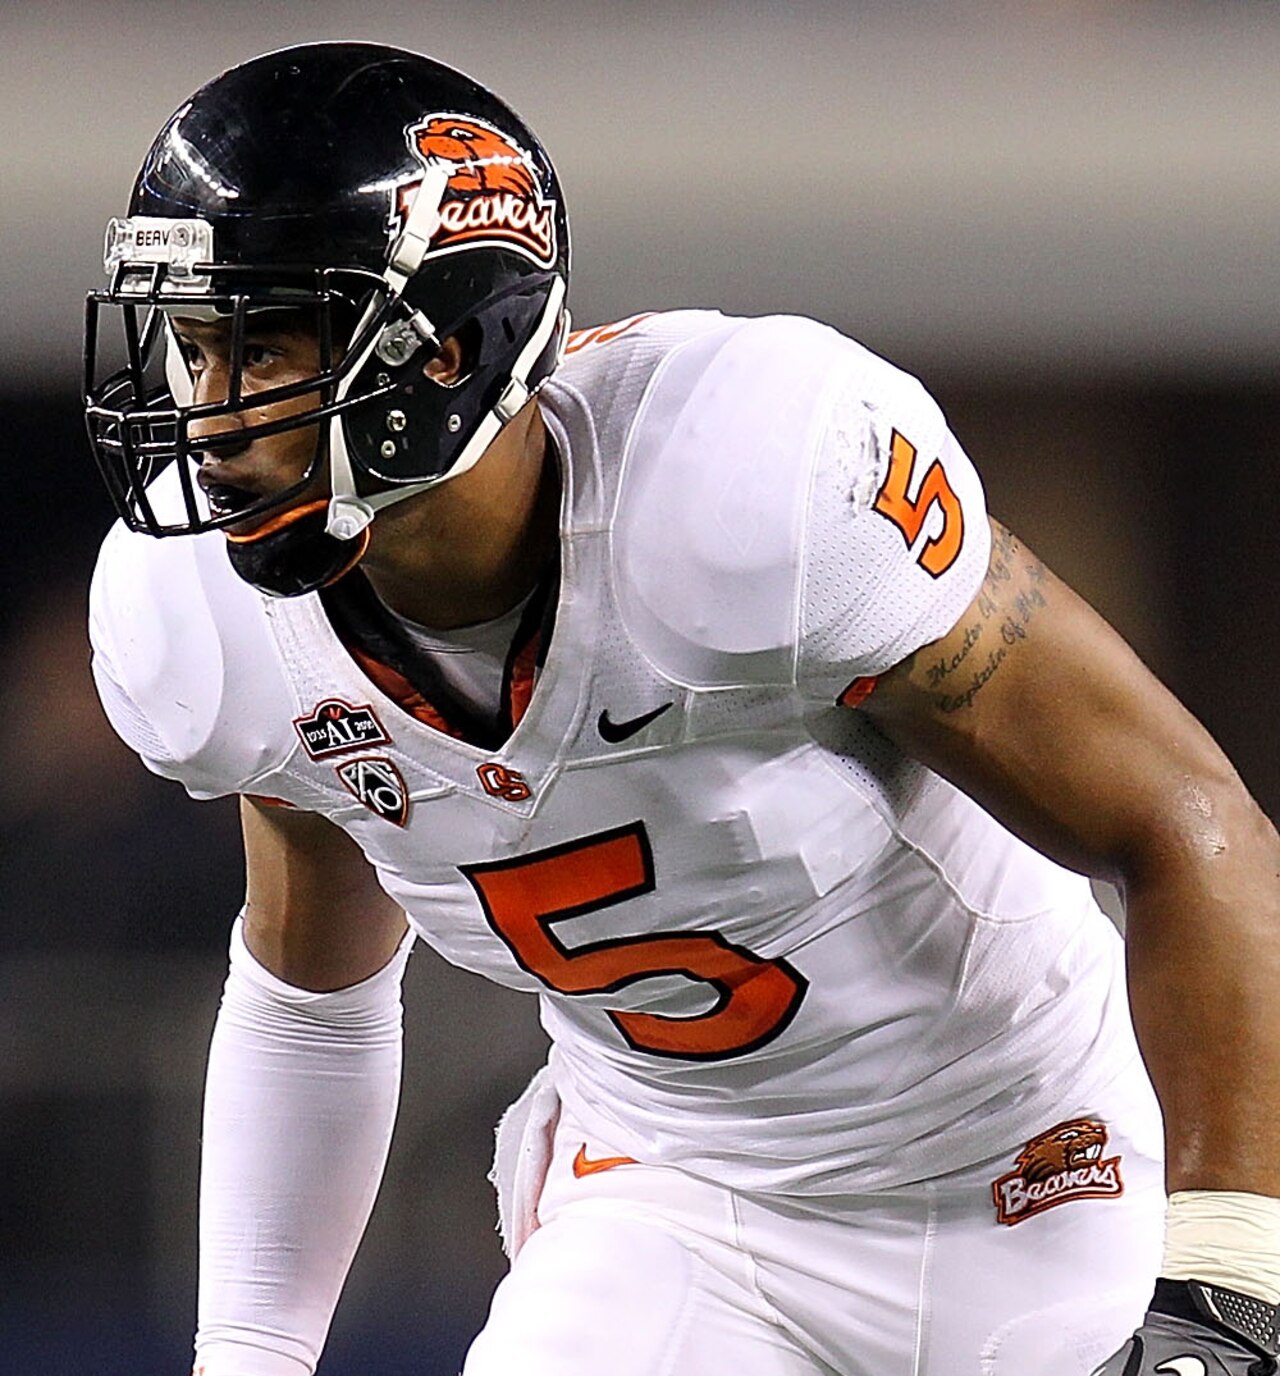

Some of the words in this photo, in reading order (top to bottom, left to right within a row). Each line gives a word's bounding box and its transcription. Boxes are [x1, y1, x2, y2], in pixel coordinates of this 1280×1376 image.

[399, 186, 552, 257] eavers
[871, 427, 965, 580] 5
[326, 718, 365, 746] AL
[457, 820, 810, 1063] 5
[1000, 1163, 1119, 1215] Beavers
